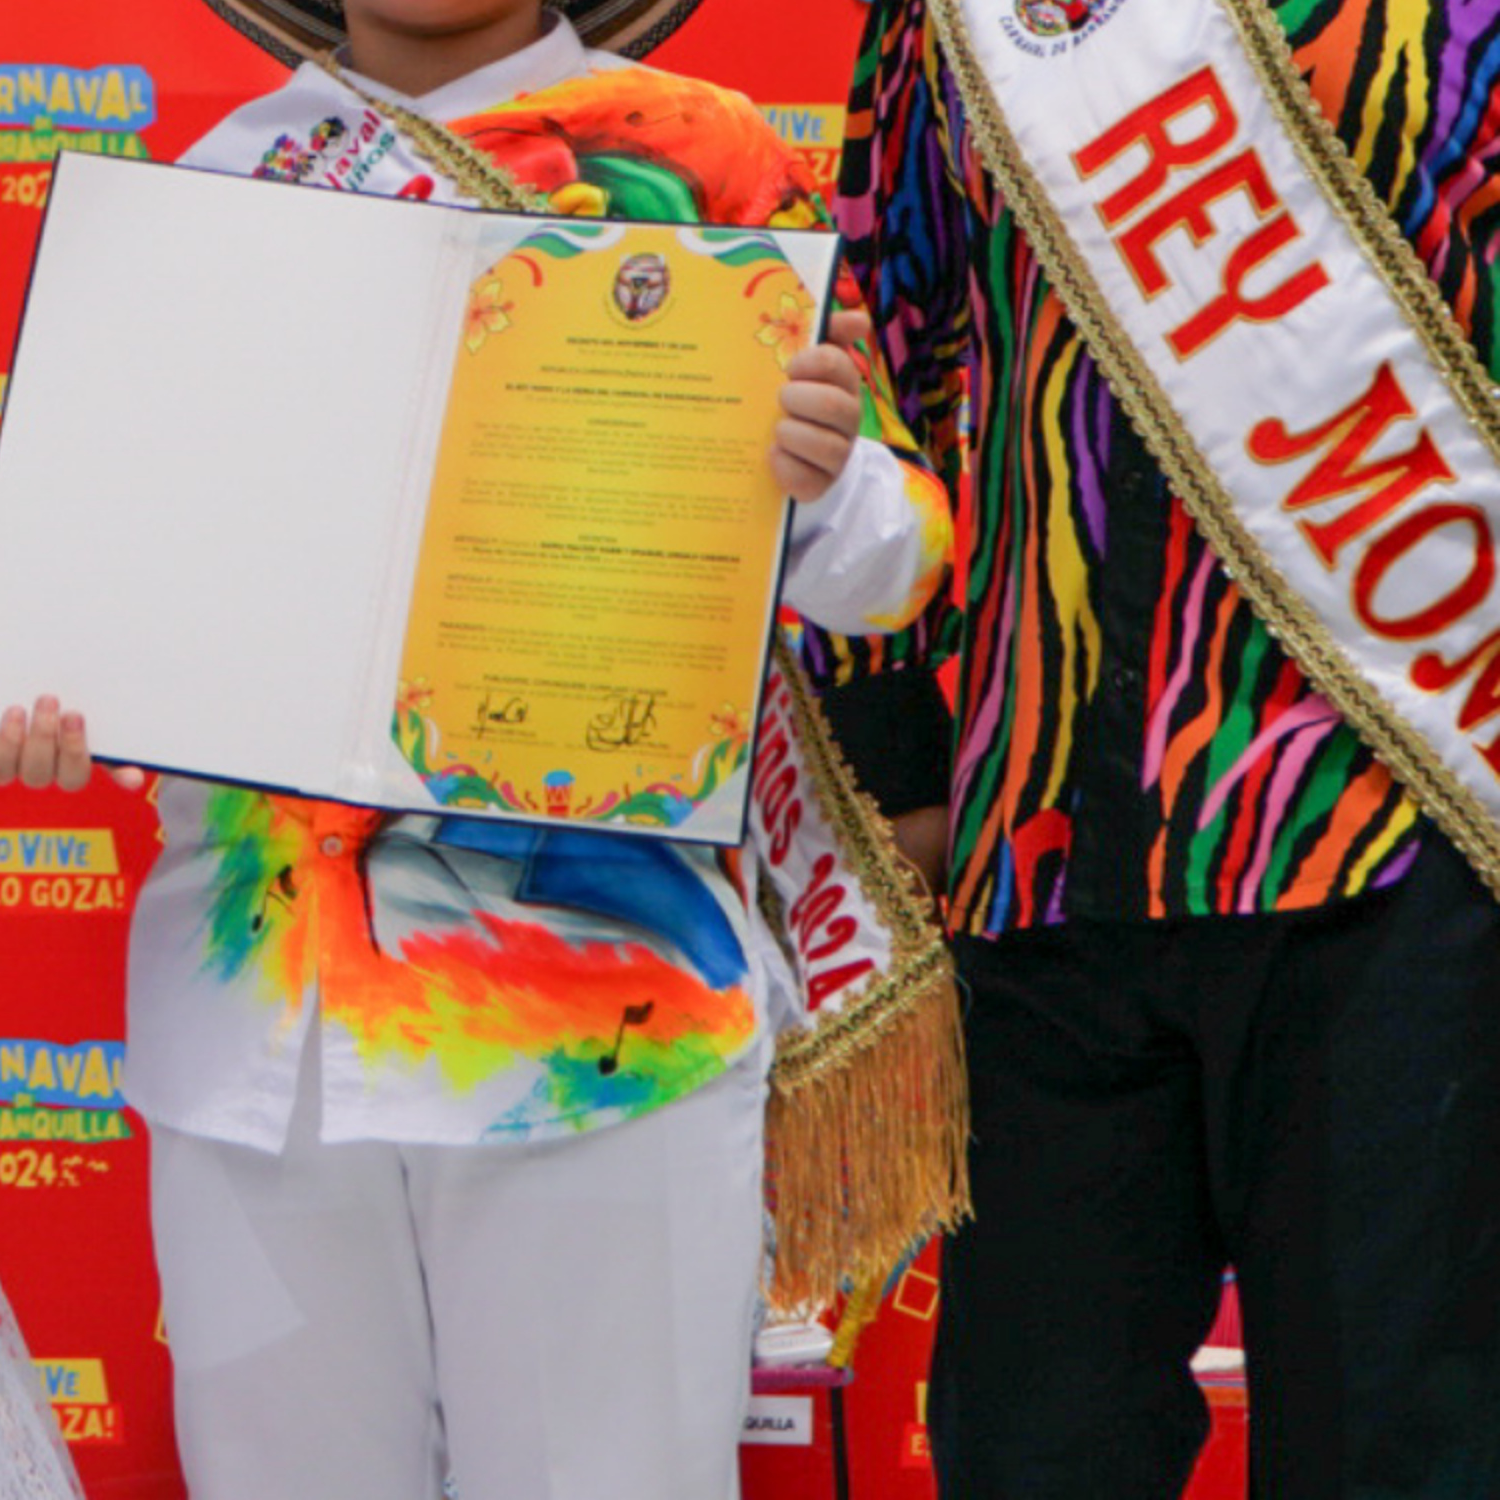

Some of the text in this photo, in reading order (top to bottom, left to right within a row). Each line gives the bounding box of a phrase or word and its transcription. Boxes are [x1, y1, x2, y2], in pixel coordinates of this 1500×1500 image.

[2, 171, 51, 209] 202
[1069, 63, 1331, 363] REY
[19, 832, 91, 867] VIVE
[31, 876, 124, 911] GOZA!
